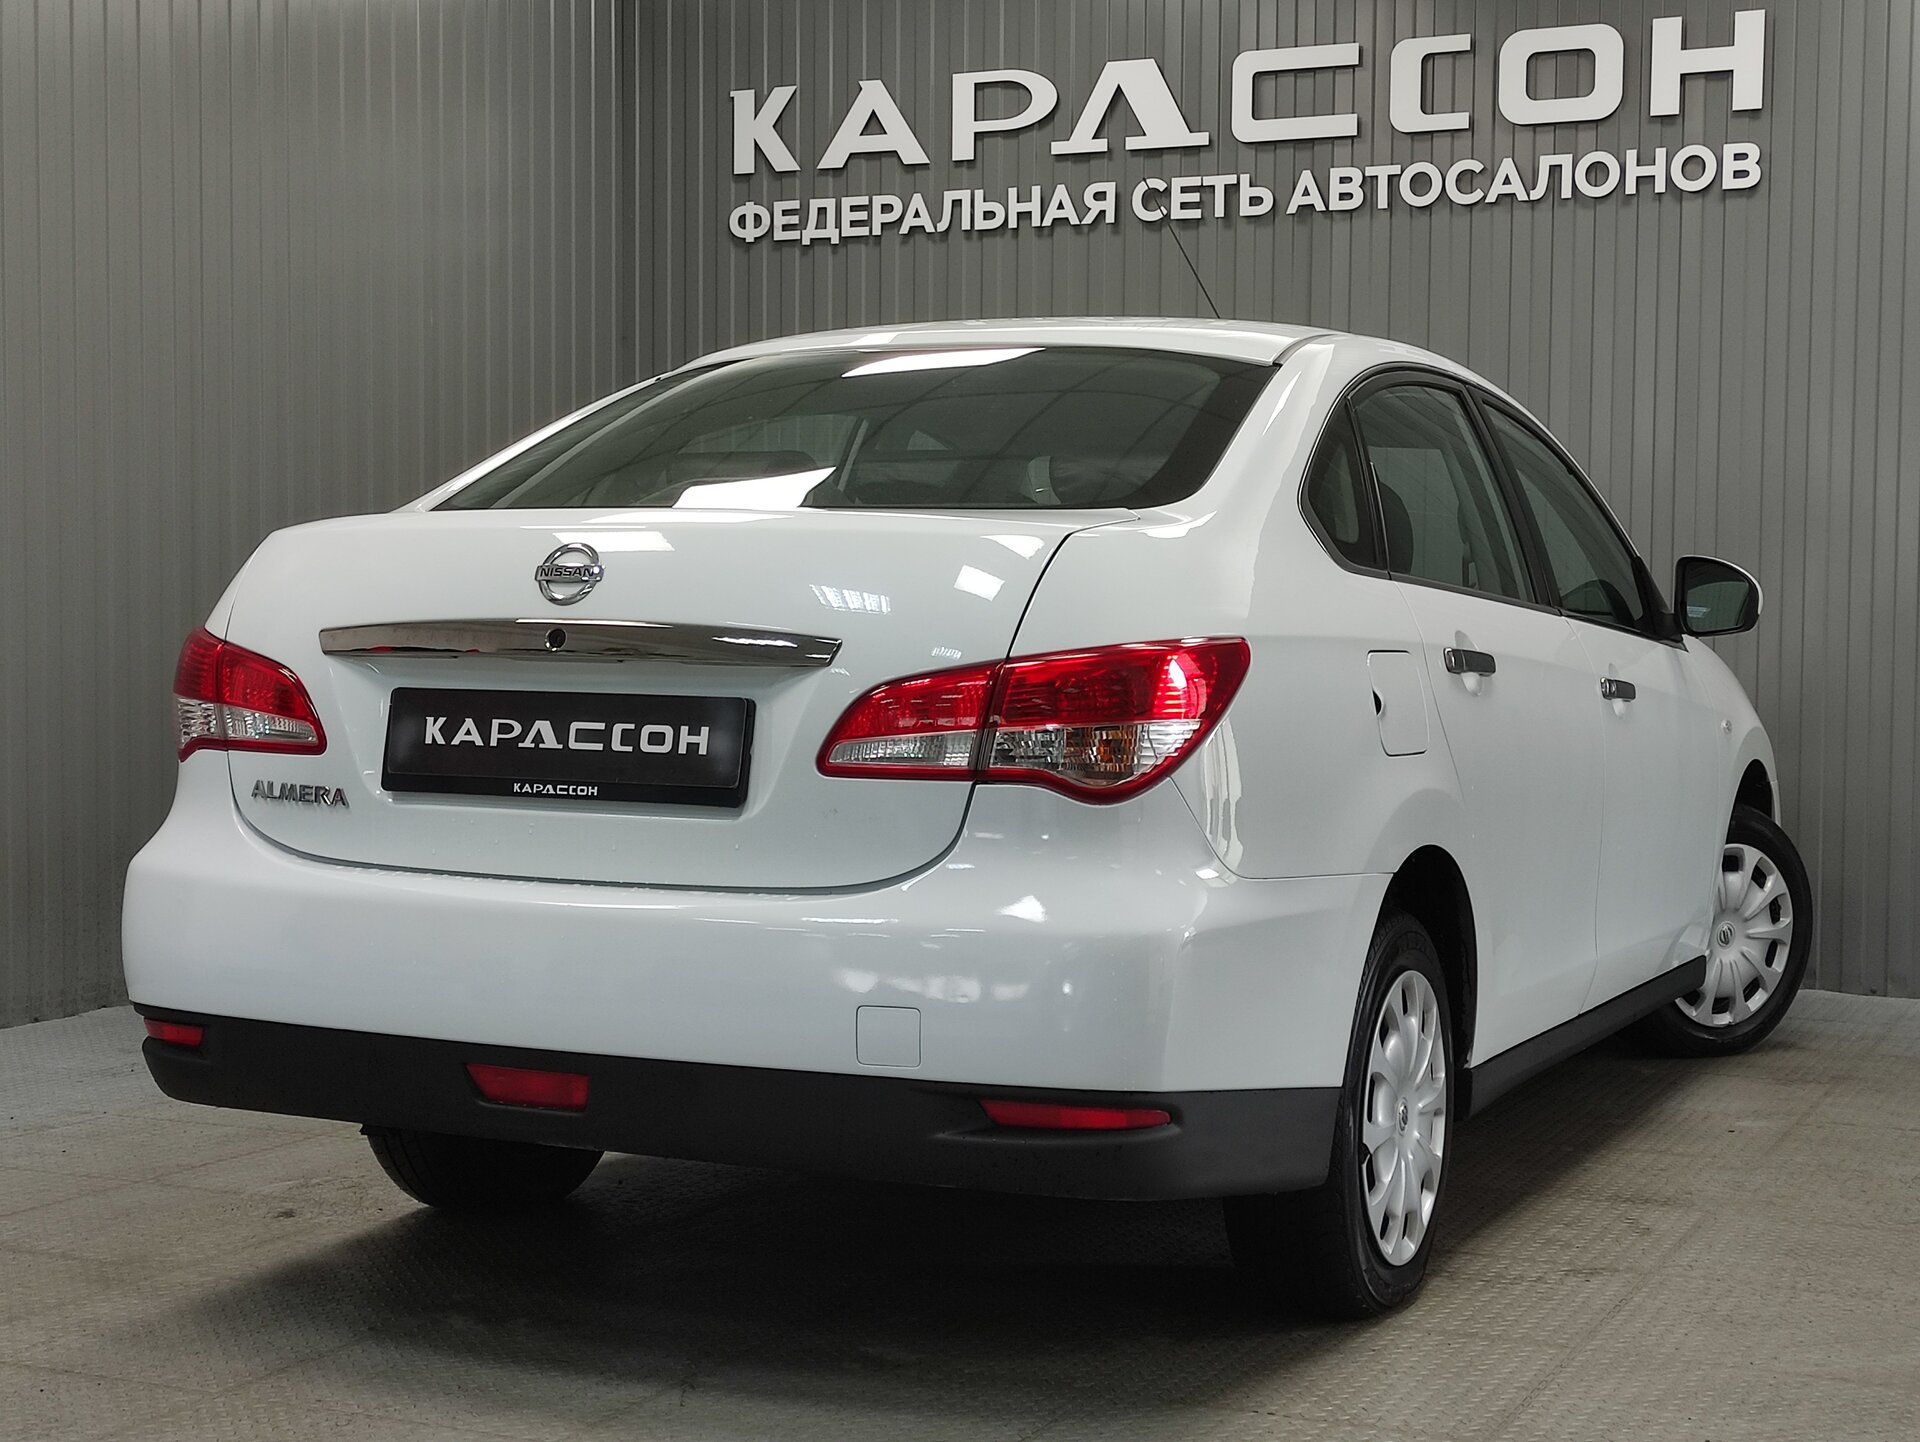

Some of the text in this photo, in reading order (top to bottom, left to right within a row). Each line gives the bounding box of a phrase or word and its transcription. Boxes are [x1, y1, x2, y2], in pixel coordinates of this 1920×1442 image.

[729, 142, 1762, 245] ФЕДЕРАЛЬНАЯ СЕТЬ АВТОСАЛОНОВ
[540, 567, 594, 577] NISSAN
[251, 780, 350, 808] ALMERA
